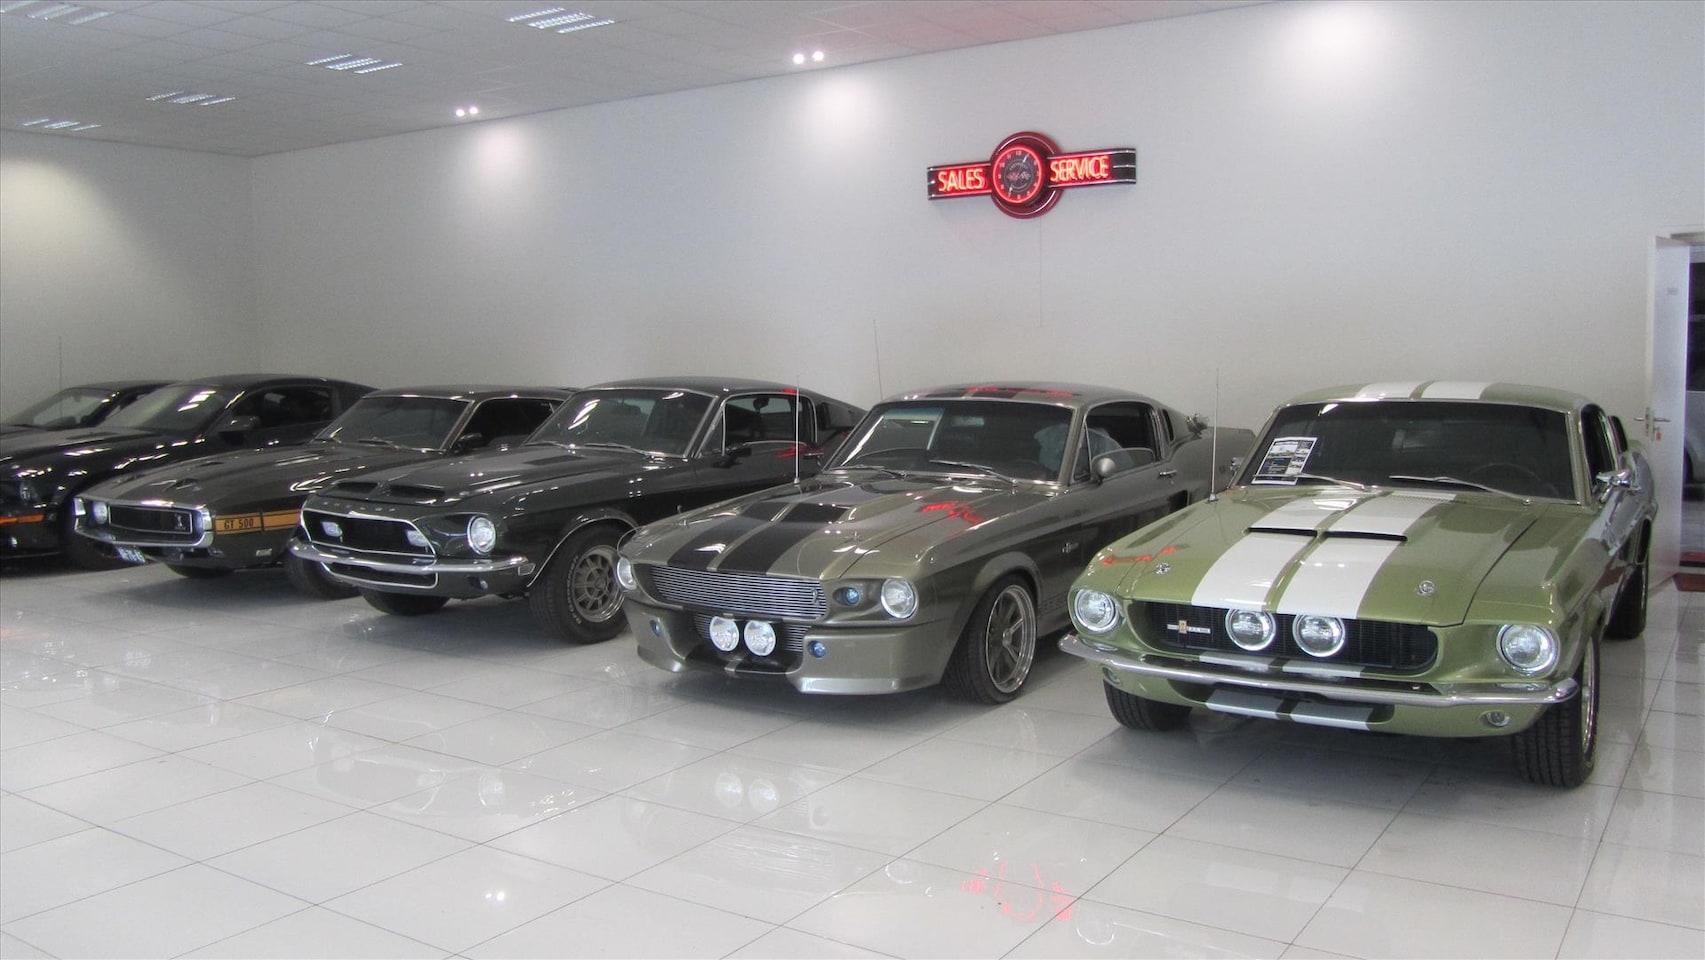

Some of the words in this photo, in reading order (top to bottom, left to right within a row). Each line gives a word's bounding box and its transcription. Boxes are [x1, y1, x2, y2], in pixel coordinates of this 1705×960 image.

[937, 168, 984, 192] SALES
[1050, 156, 1109, 182] SERVICE
[224, 520, 234, 530] GT
[238, 518, 254, 529] 500
